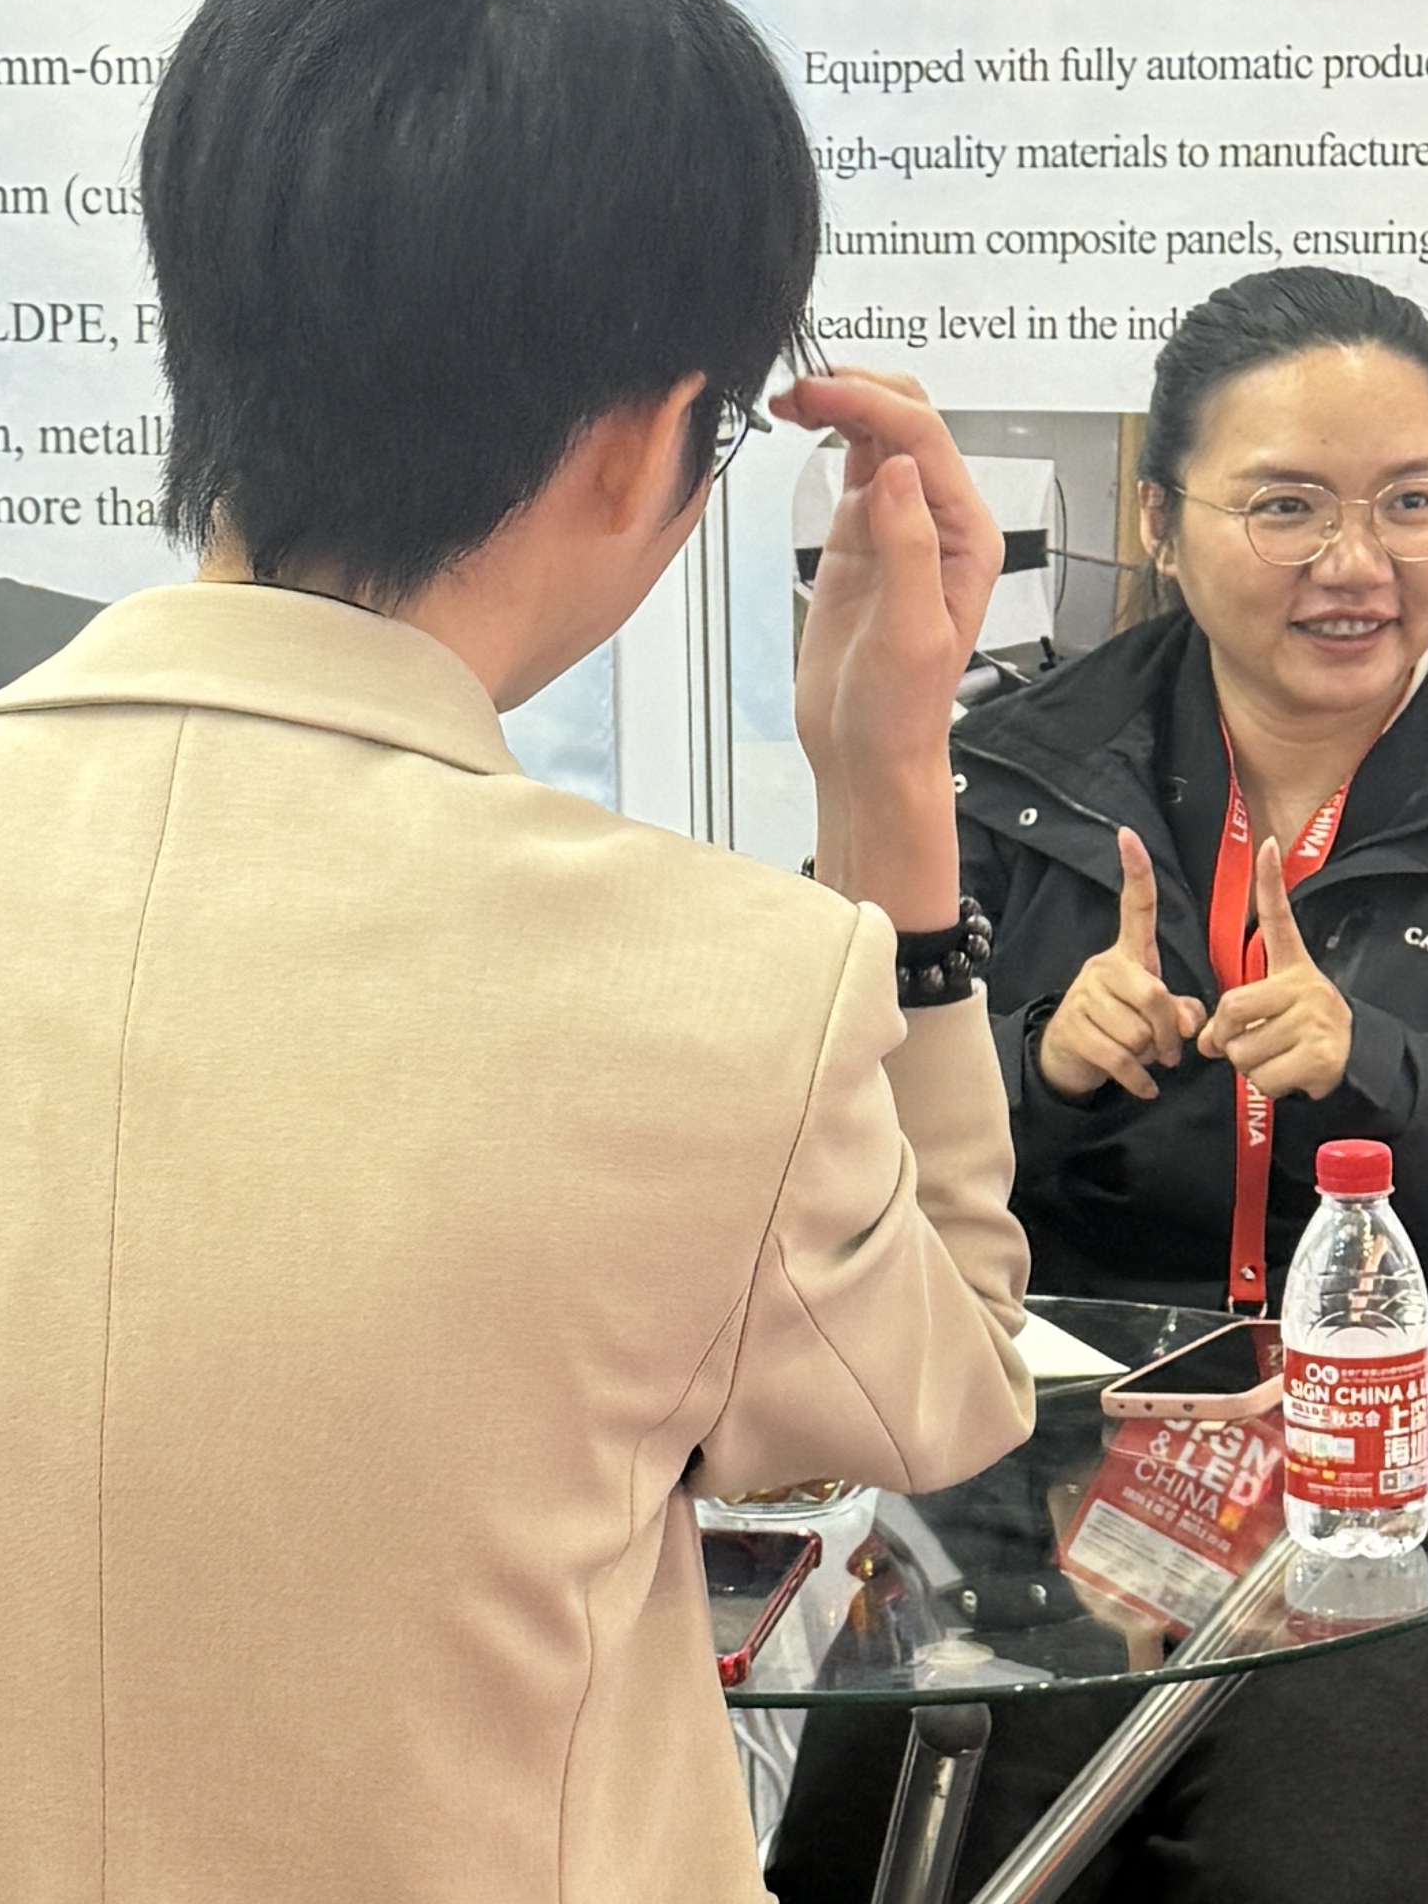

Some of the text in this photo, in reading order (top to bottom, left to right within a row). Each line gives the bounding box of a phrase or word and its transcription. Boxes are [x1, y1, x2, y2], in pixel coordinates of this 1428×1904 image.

[804, 48, 965, 94] Equipped
[974, 47, 1050, 83] with
[1060, 46, 1138, 91] fully
[1146, 44, 1314, 81] automatic
[1016, 133, 1168, 169] materials
[1177, 139, 1210, 168] to
[814, 220, 977, 256] luminum
[985, 219, 1157, 264] composite
[1165, 220, 1283, 265] panels,
[938, 305, 1017, 340] level
[1027, 305, 1058, 340] in
[1067, 305, 1118, 341] the
[1290, 1378, 1330, 1403] SIGN
[1335, 1384, 1404, 1405] CHINA
[1135, 1457, 1220, 1520] CHINA
[1149, 1430, 1262, 1507] & LED
